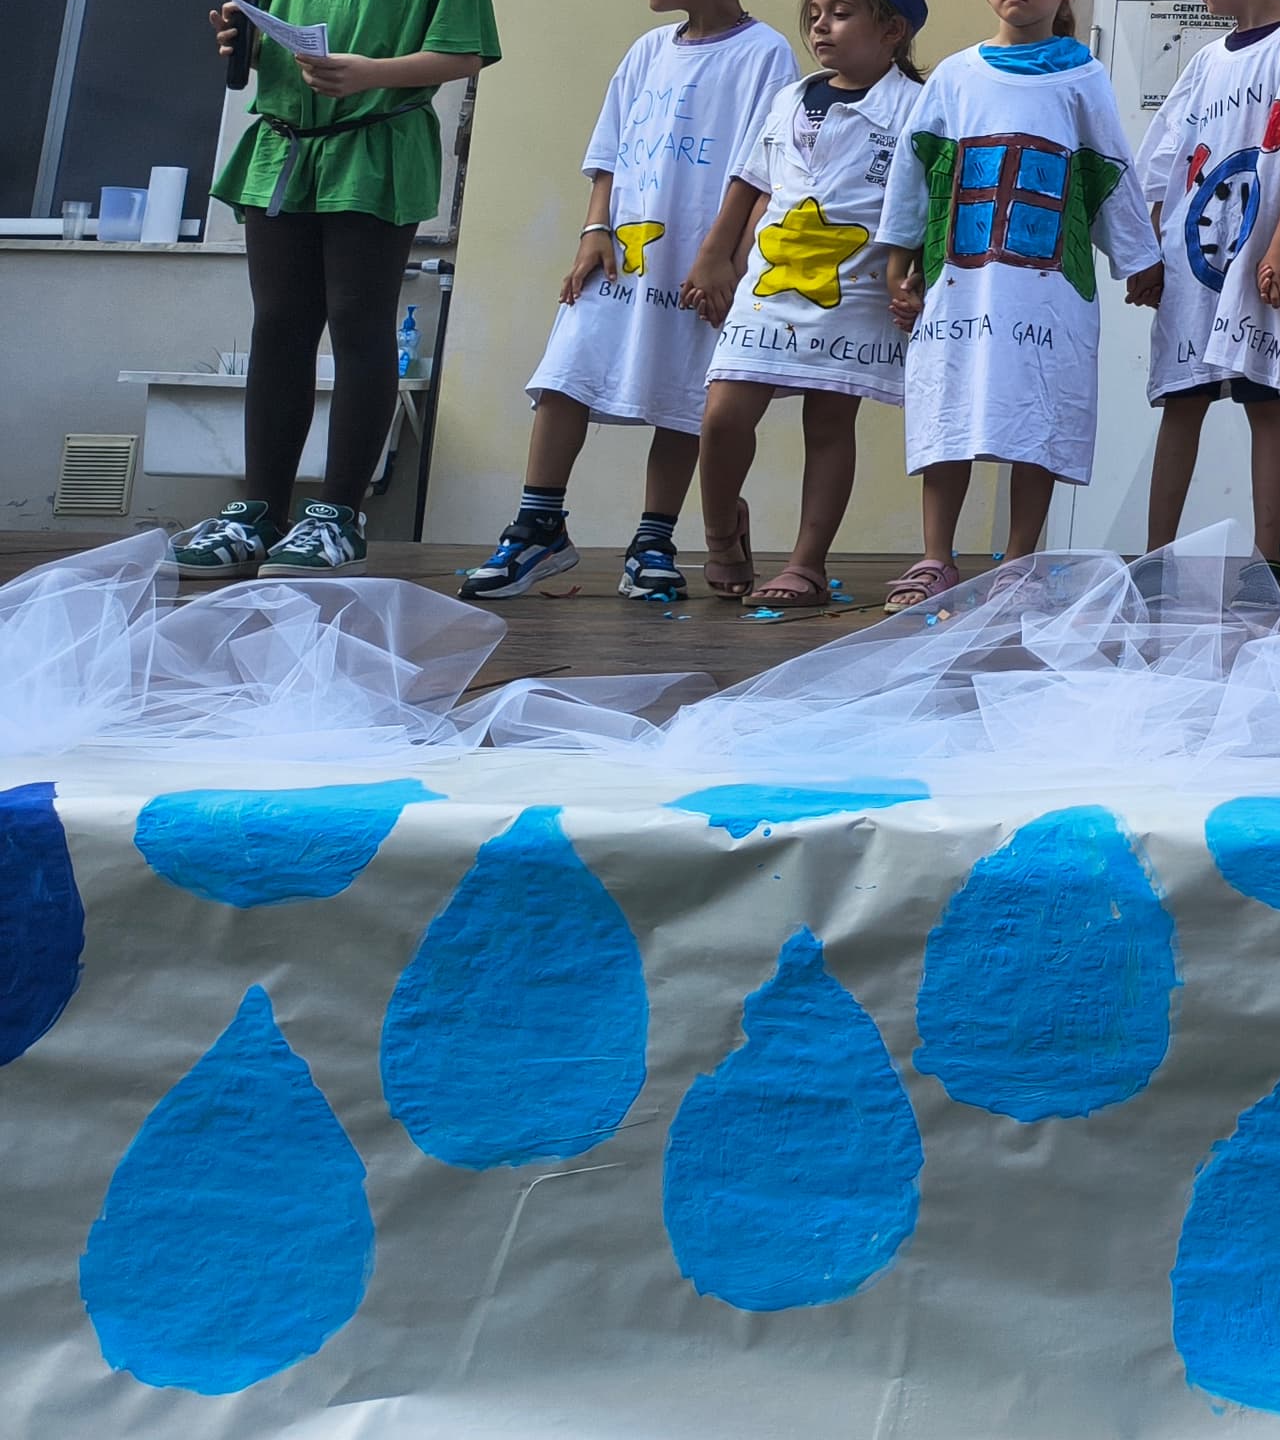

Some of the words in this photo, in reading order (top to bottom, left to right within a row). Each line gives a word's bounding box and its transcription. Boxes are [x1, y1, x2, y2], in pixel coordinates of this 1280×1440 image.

[1173, 4, 1208, 13] CENTR
[617, 132, 716, 169] ROVARE
[599, 280, 636, 304] BIM
[719, 321, 797, 353] STELLA
[810, 338, 824, 351] DI
[829, 336, 905, 367] CECILIA
[1012, 321, 1053, 350] GAIA
[1177, 340, 1197, 364] LA
[1214, 317, 1229, 333] DI
